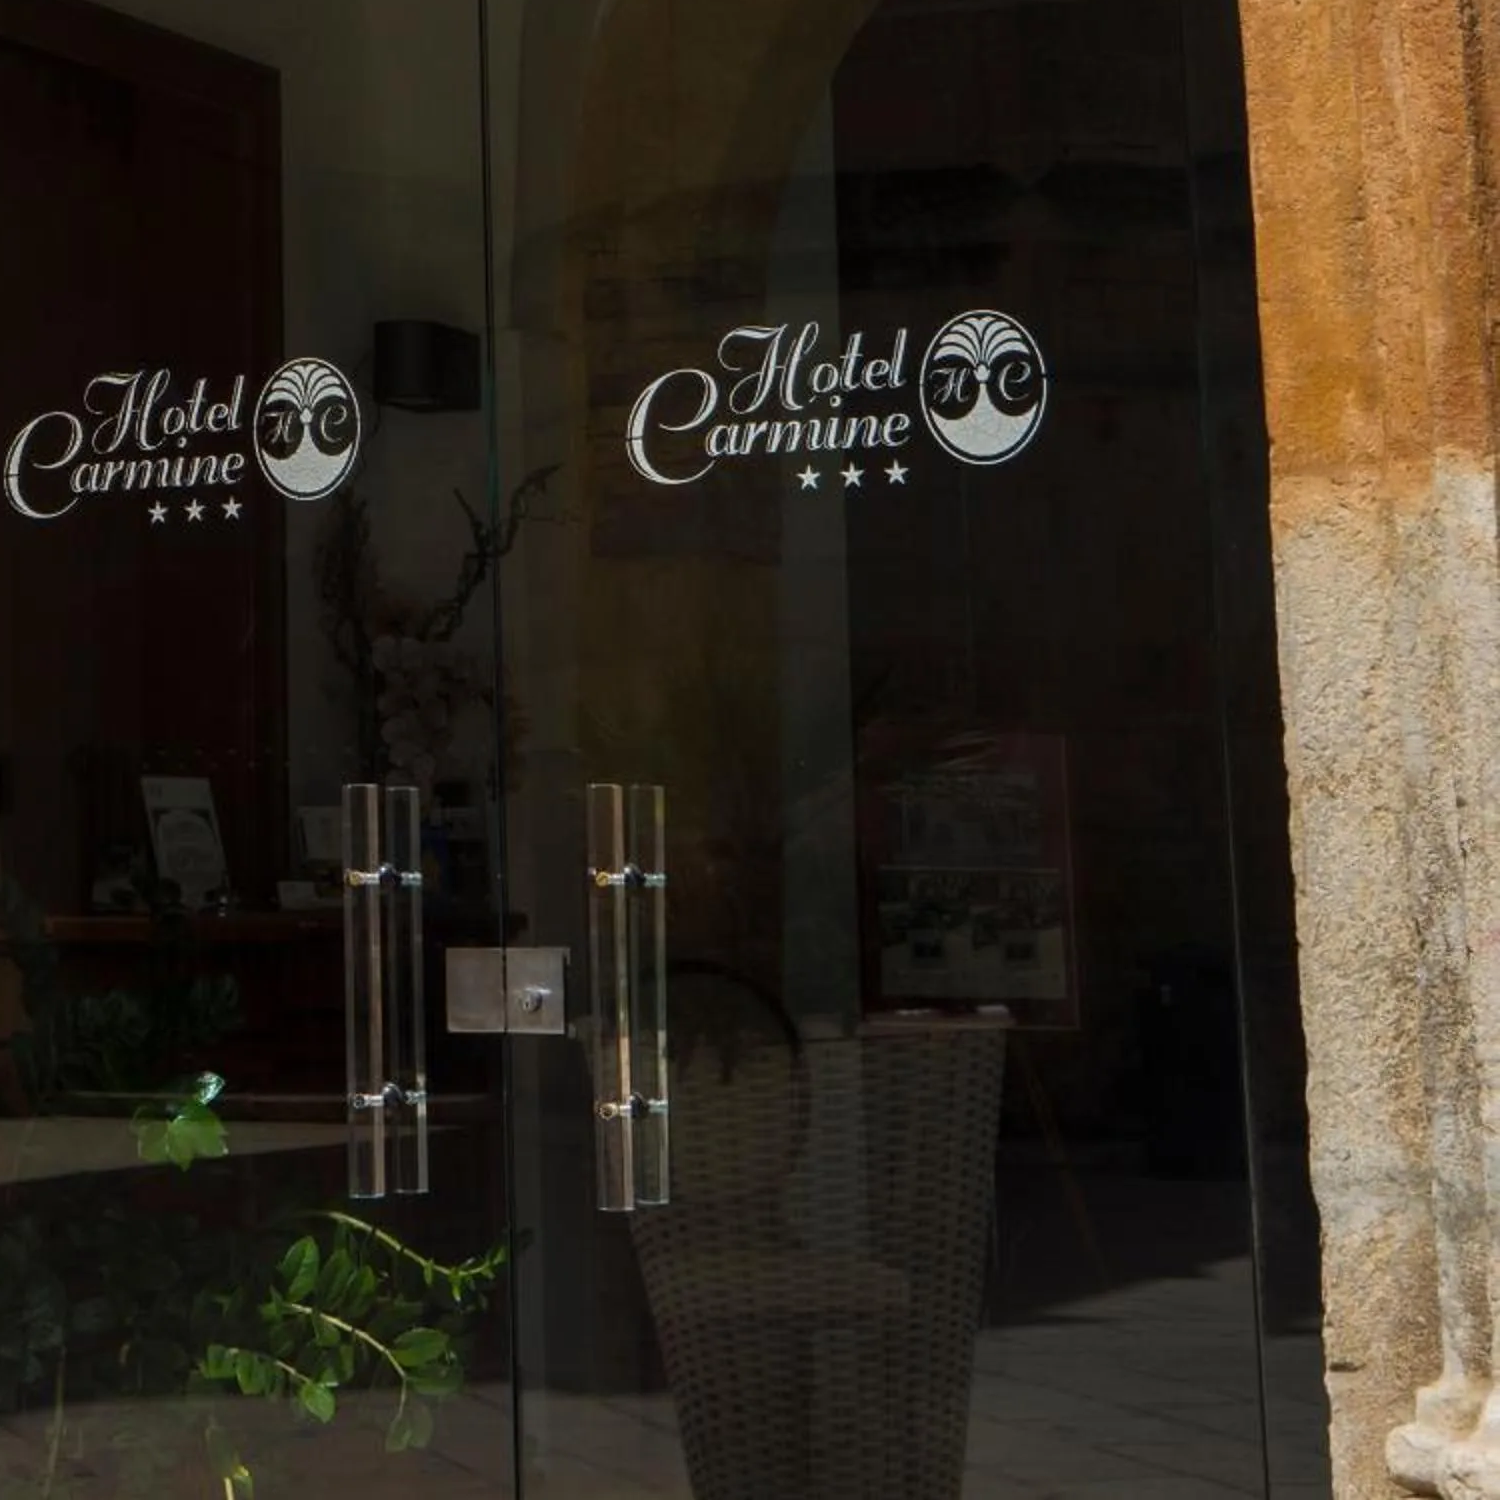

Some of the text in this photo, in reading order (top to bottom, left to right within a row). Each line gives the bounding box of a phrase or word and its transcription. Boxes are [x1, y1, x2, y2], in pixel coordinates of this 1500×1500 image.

[84, 368, 244, 454] Hotel
[717, 320, 908, 415] Hotel
[3, 410, 245, 519] Carmine
[625, 368, 912, 486] Carmine
